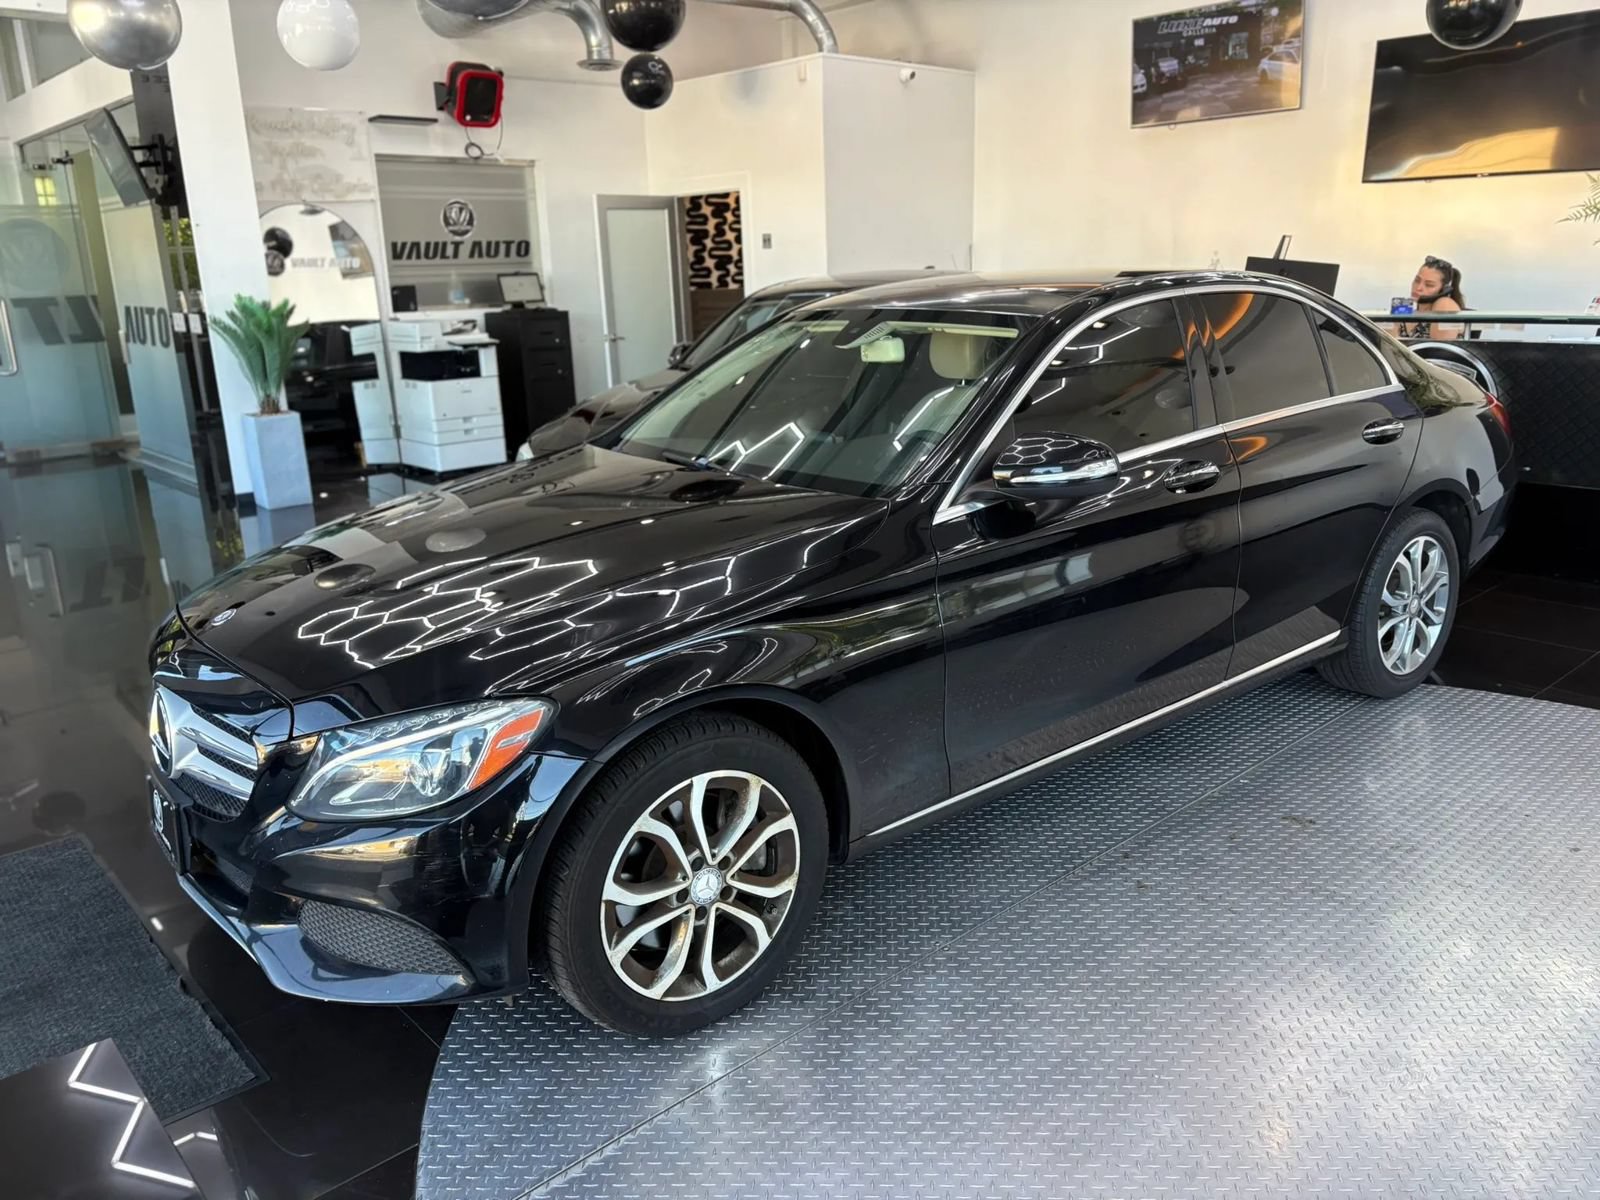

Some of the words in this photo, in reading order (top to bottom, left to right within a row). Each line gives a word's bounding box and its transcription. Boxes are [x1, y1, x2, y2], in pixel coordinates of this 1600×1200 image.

[391, 241, 464, 261] VAULT
[468, 240, 530, 259] AUTO
[124, 305, 171, 349] AUTO
